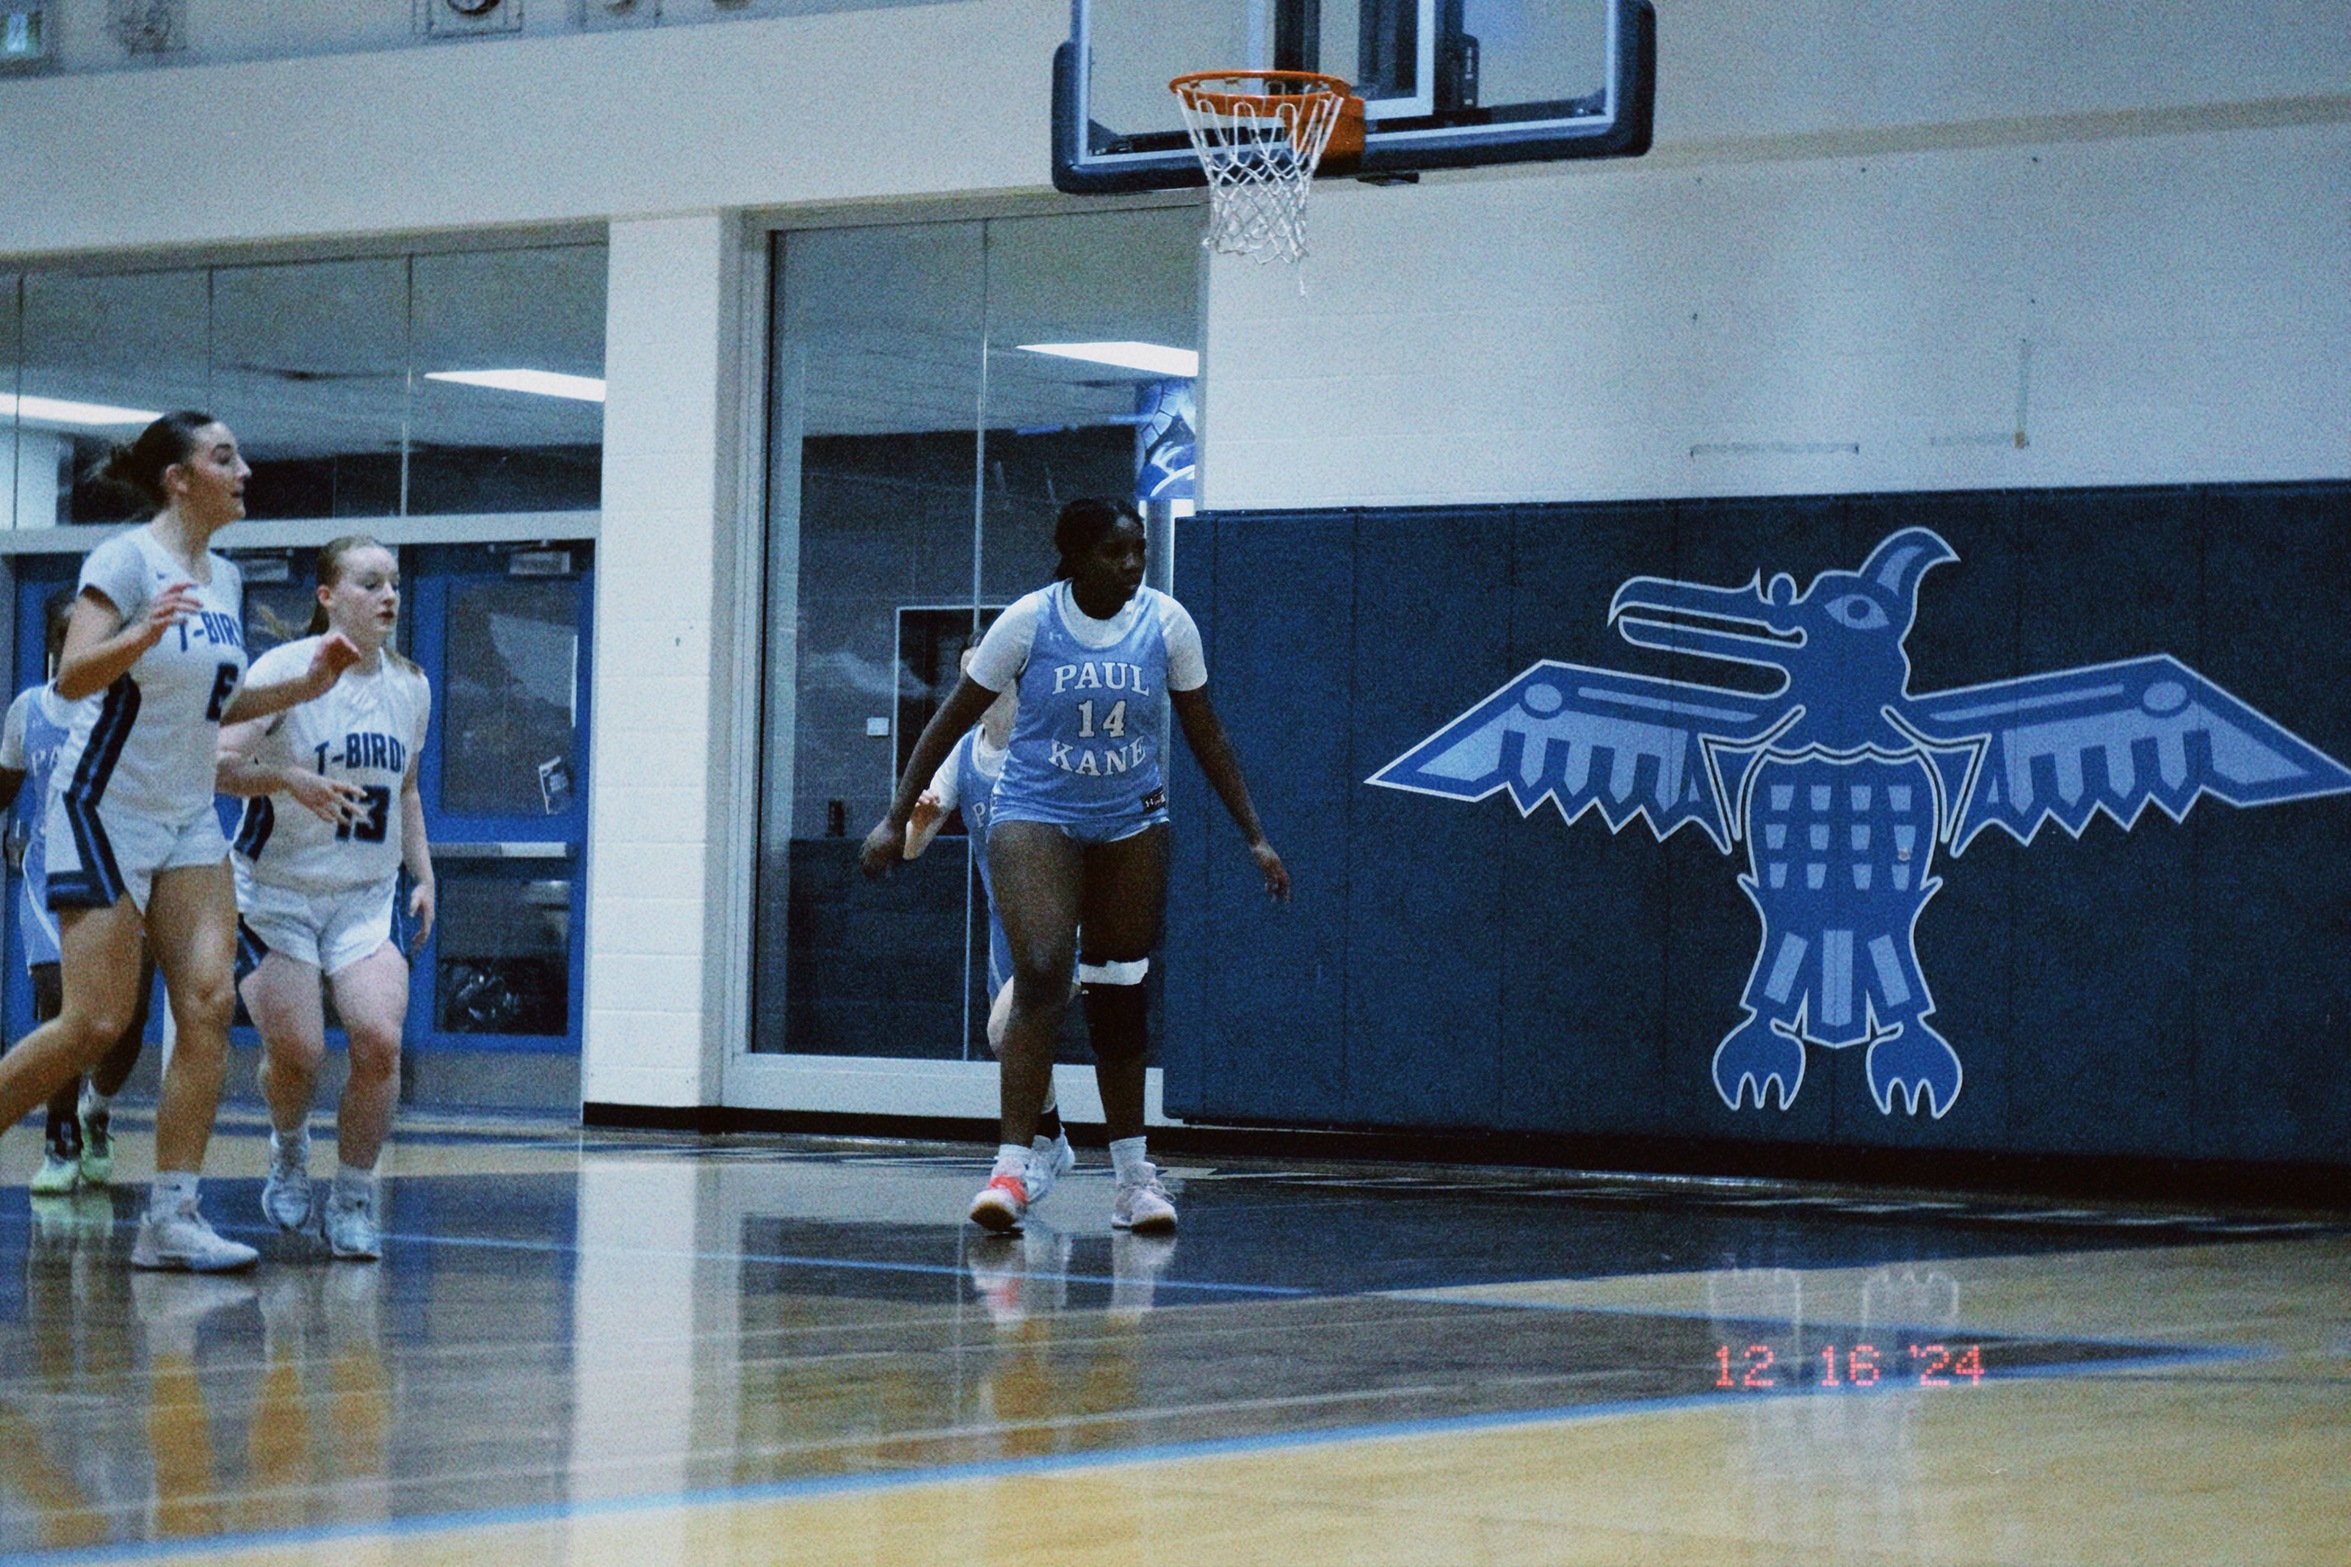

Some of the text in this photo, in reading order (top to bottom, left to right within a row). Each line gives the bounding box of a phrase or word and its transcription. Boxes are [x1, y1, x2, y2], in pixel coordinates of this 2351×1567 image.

[1052, 661, 1150, 697] PAUL
[1077, 699, 1126, 738] 14
[1048, 736, 1148, 777] KANE
